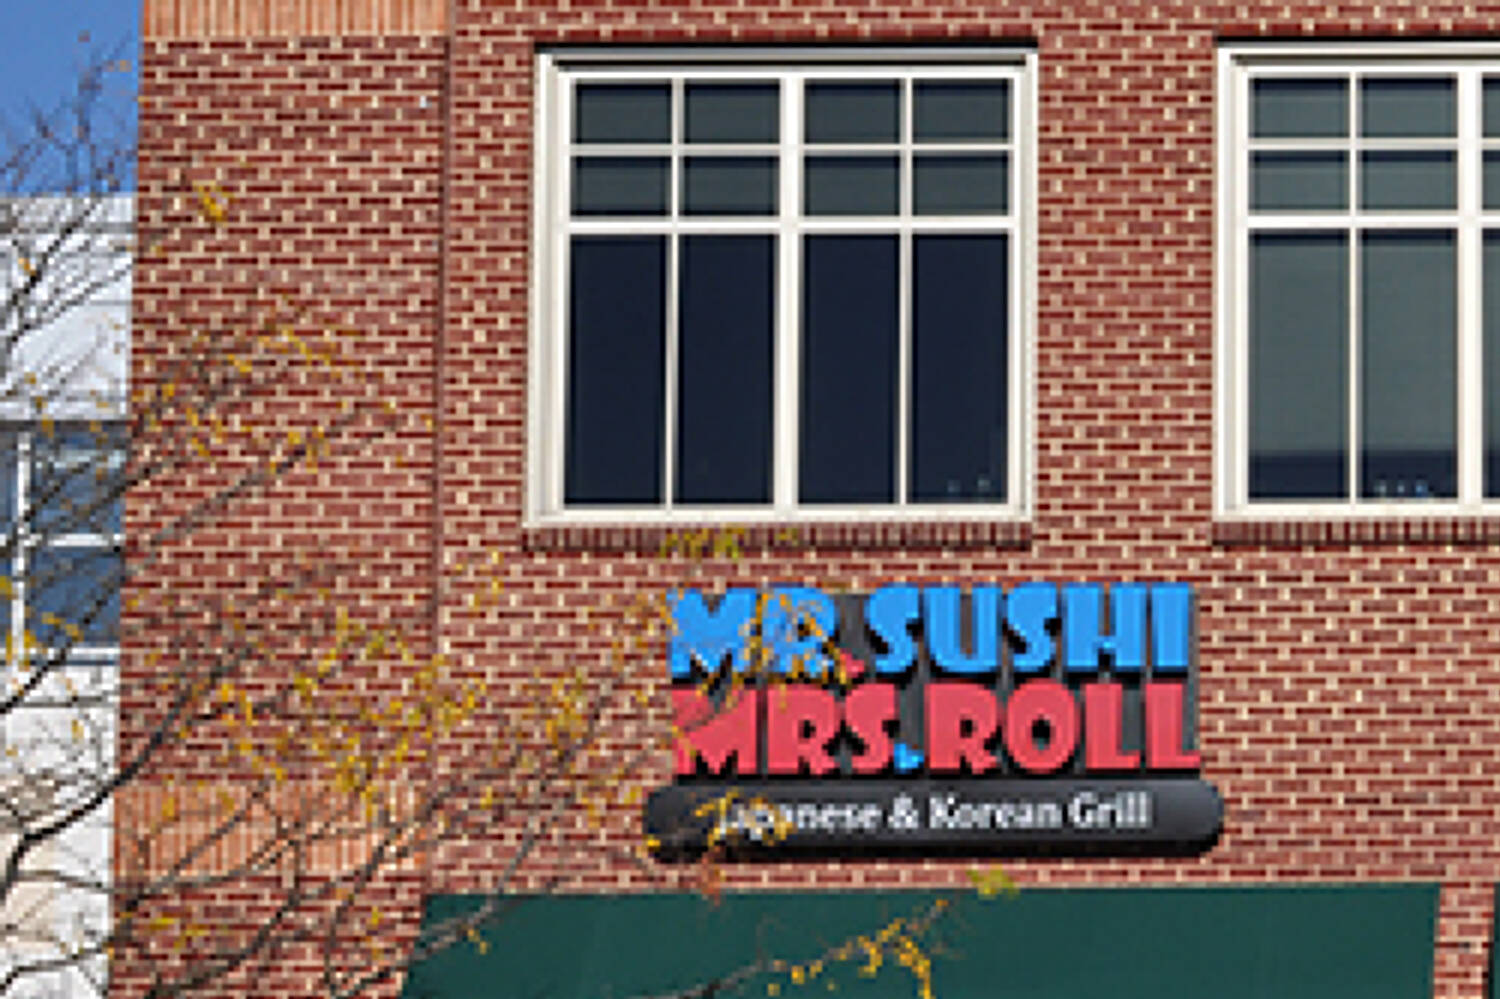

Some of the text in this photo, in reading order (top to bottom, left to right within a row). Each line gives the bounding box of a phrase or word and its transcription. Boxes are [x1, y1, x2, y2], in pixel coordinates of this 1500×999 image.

[866, 582, 1189, 674] SUSHI
[924, 679, 1201, 774] ROLL
[888, 795, 919, 829] &
[929, 795, 1062, 829] Korean
[1068, 790, 1152, 828] Grill
